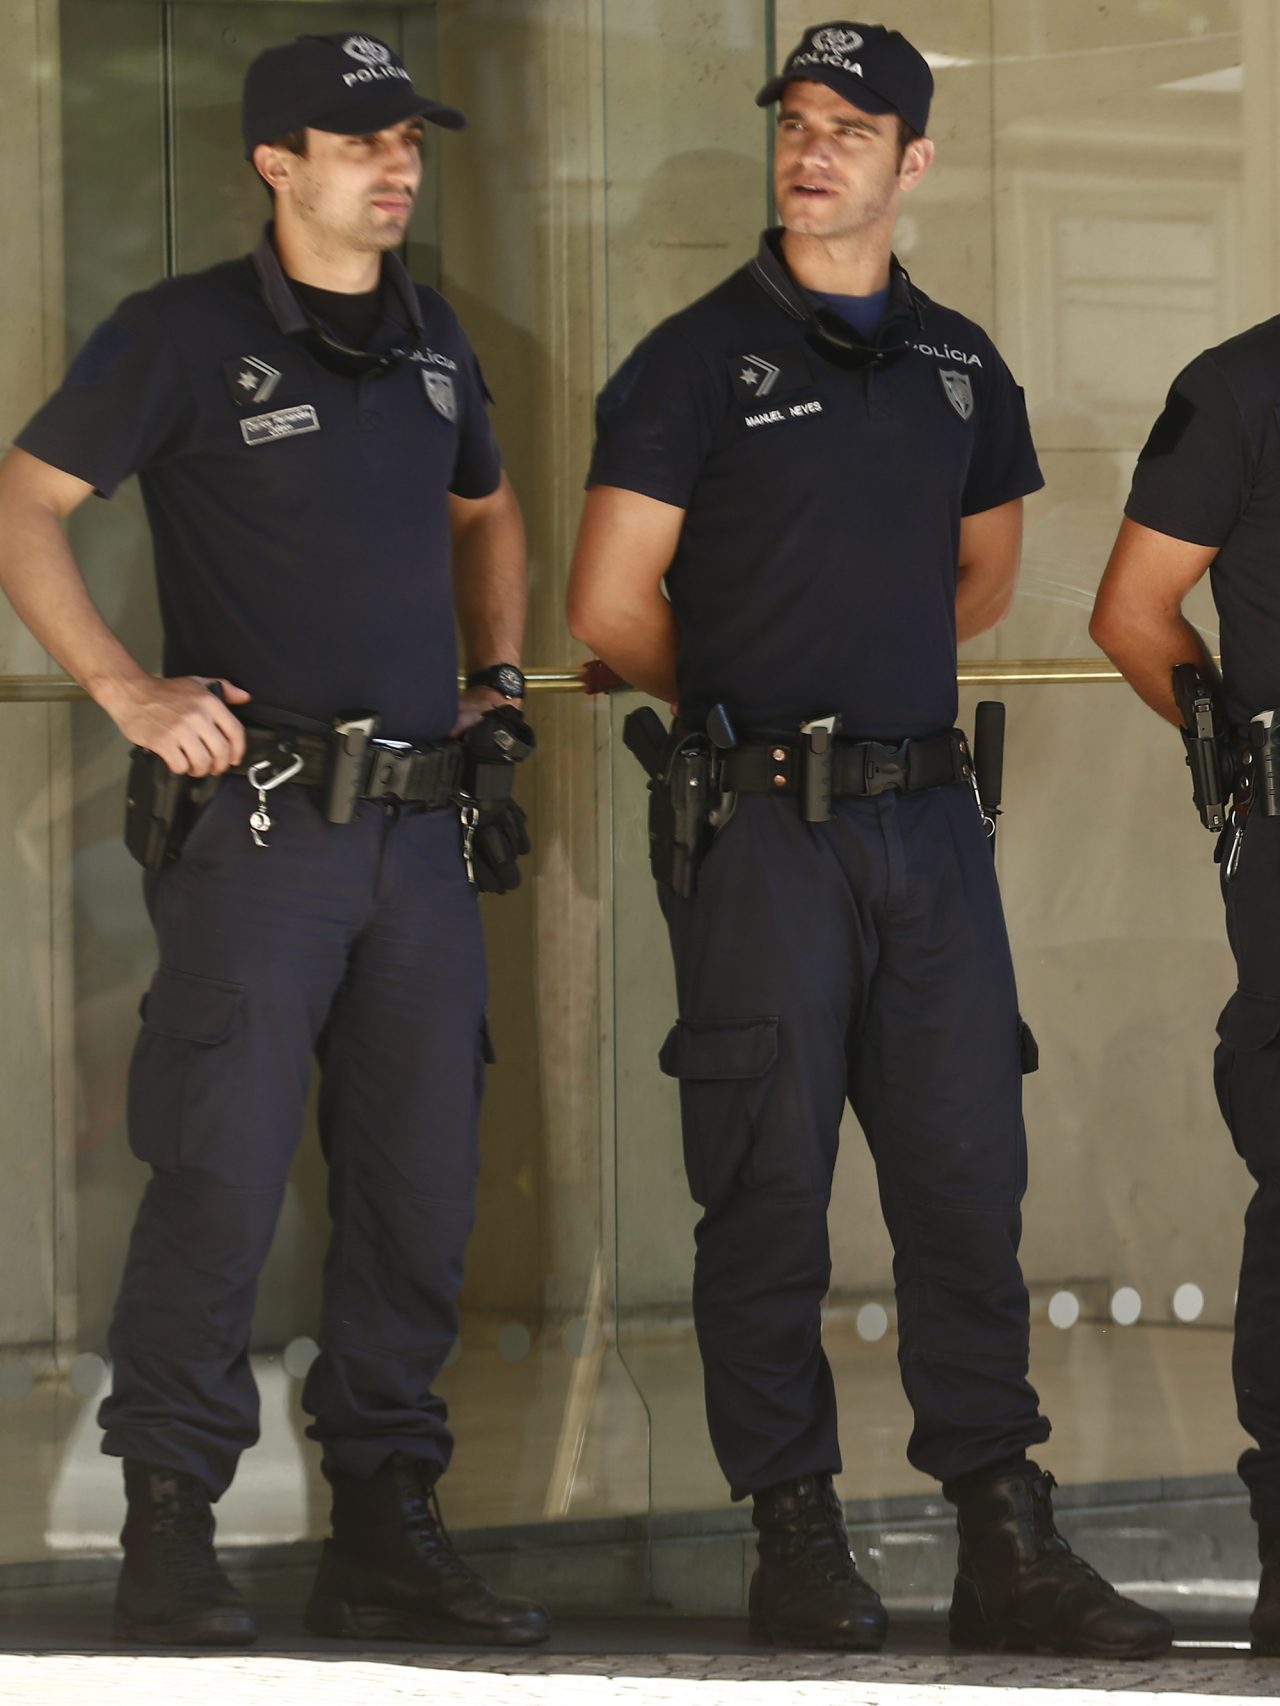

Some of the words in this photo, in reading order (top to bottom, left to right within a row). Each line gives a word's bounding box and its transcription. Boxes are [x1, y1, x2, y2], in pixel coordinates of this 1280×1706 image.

[904, 340, 983, 368] OLÍCIA
[745, 411, 786, 428] MANUEL
[789, 401, 823, 417] NEVES
